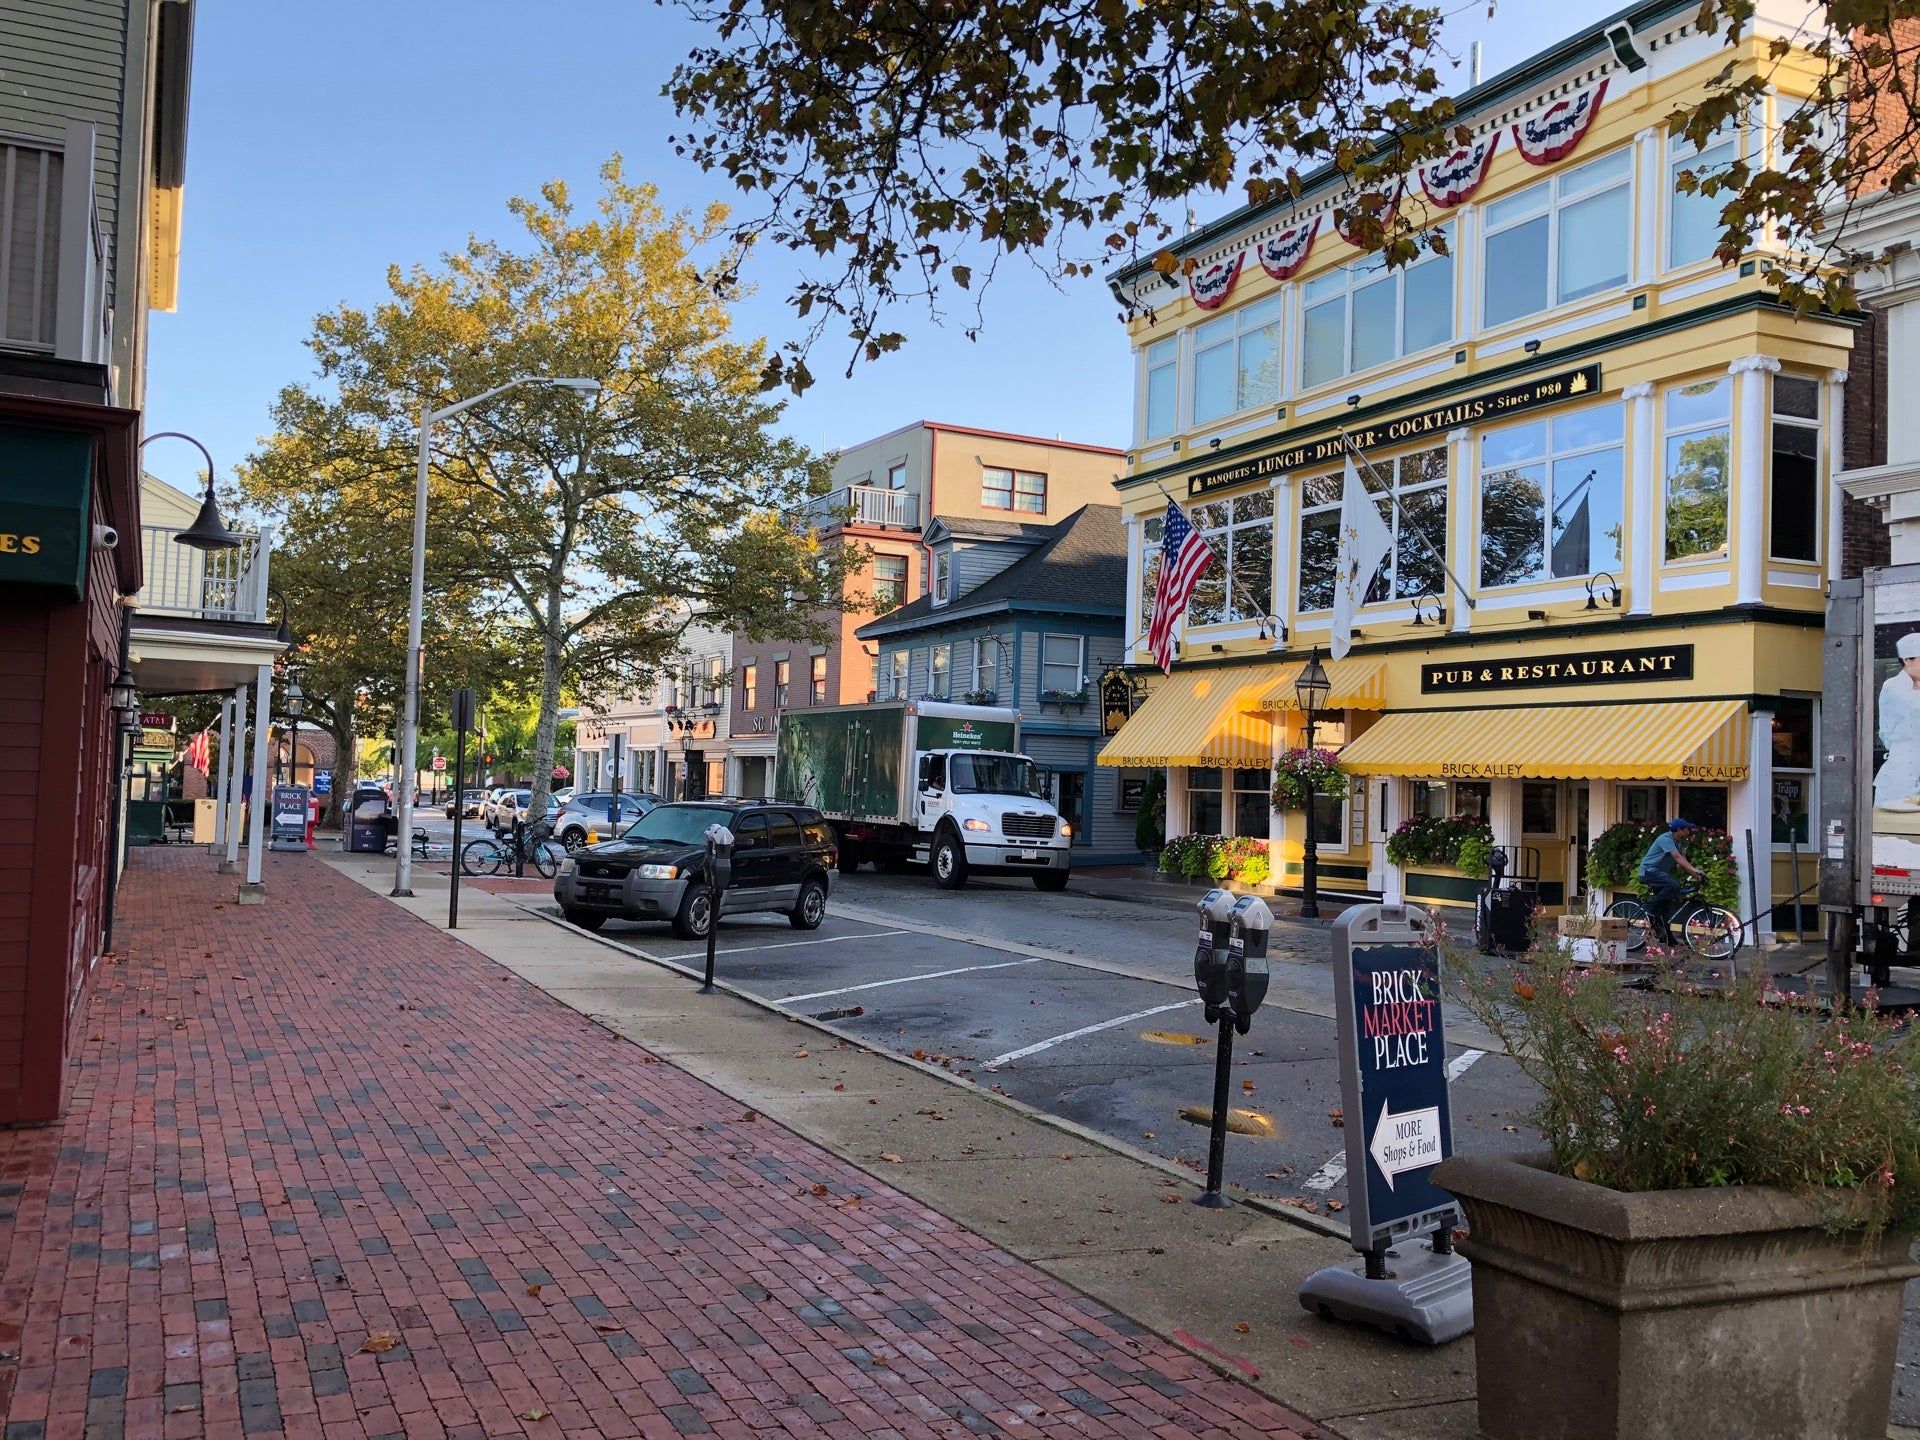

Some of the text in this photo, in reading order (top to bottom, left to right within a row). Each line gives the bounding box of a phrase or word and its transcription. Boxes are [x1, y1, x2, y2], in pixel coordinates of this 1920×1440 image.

[1206, 467, 1250, 486] BANQUETS
[1257, 449, 1305, 475] LUNCH
[1388, 401, 1485, 440] COCKTAILS
[1497, 392, 1530, 409] Since
[1535, 382, 1562, 400] 1980
[1431, 655, 1676, 685] PUB & RESTAURANT
[1262, 699, 1290, 710] BRICK
[143, 716, 165, 724] ATM
[953, 731, 982, 739] Heineken
[1122, 756, 1169, 765] BRICK ALLEY
[1200, 756, 1269, 767] BRICK ALLEY
[1442, 763, 1523, 775] BRICK ALLEY
[1682, 765, 1748, 778] BRICK ALLEY
[280, 792, 302, 800] BRICK
[1775, 782, 1799, 798] Trapp
[279, 802, 302, 810] PLACE
[1371, 969, 1426, 1006] BRICK
[1362, 999, 1436, 1039] MARKET
[1373, 1030, 1429, 1070] PLACE
[1395, 1119, 1423, 1141] MORE
[1383, 1135, 1436, 1165] Shops & Food
